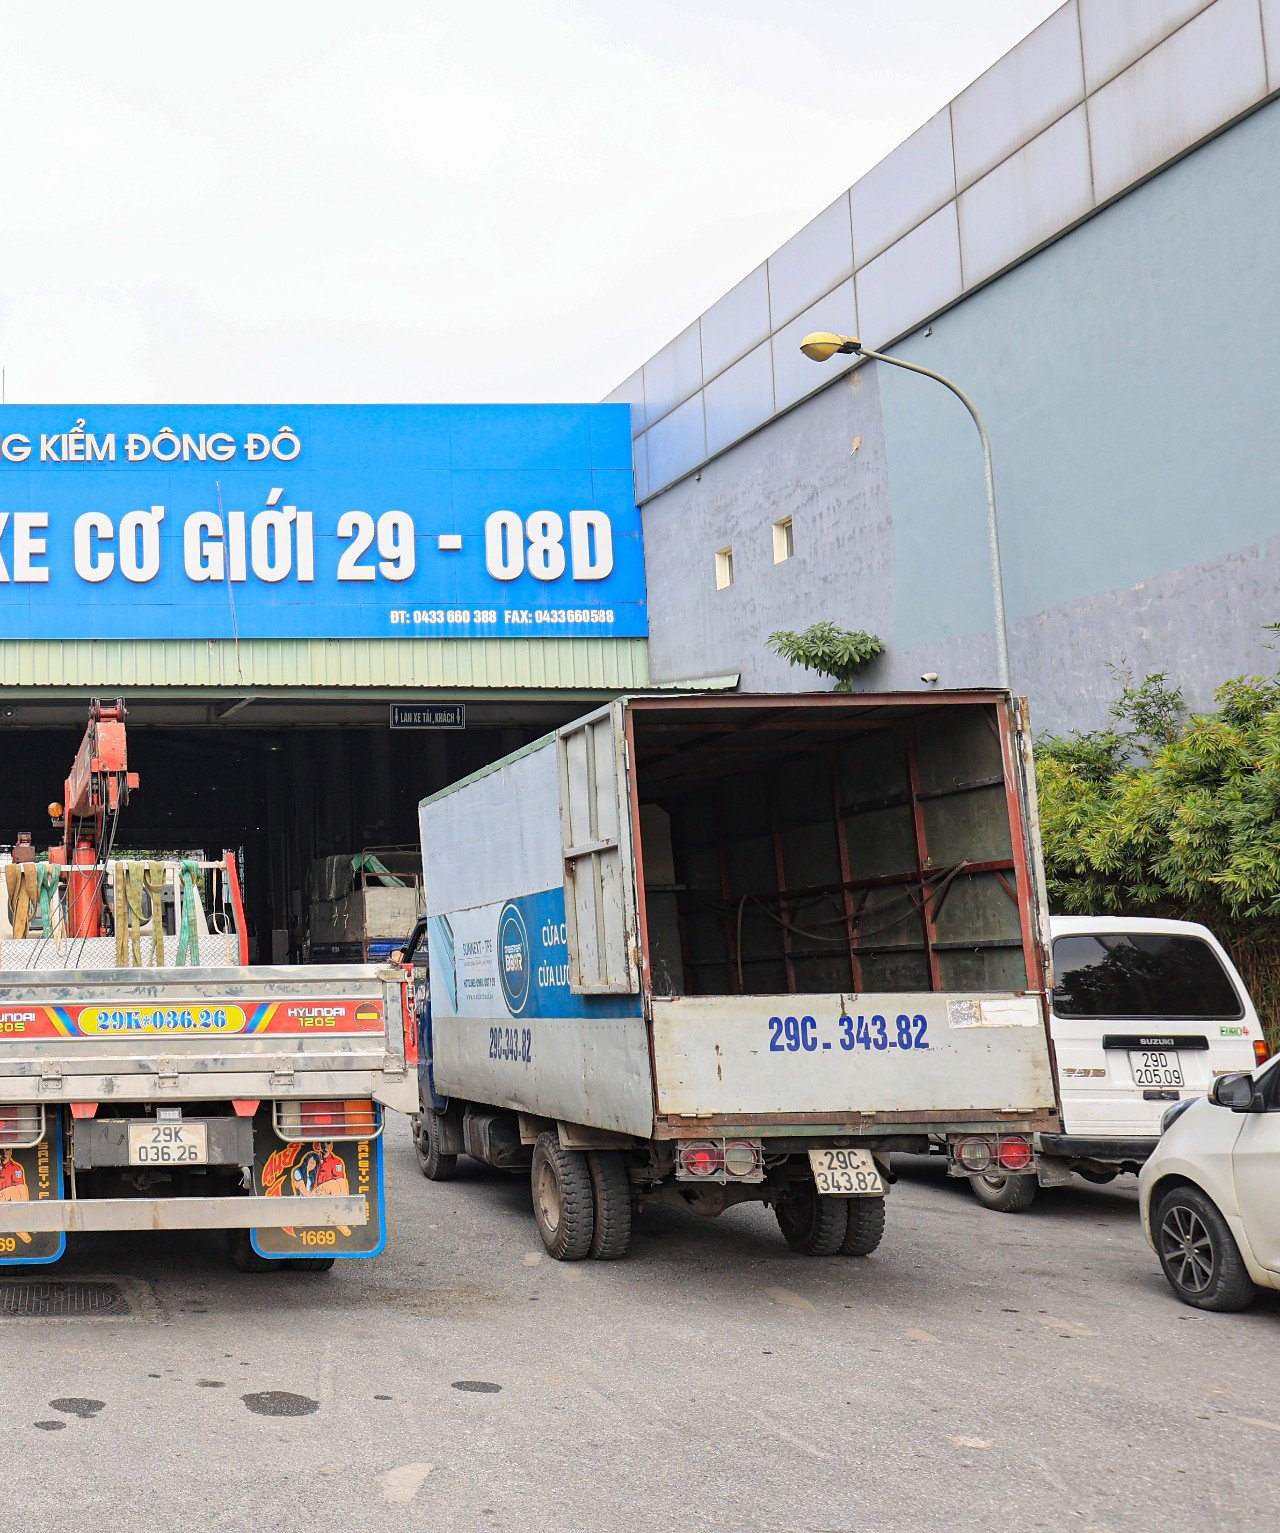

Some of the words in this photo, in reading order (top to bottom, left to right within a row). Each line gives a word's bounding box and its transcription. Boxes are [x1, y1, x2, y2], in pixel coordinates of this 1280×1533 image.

[40, 418, 116, 462] KIỂM
[125, 426, 236, 462] ĐÔNG
[244, 425, 302, 462] ĐÔ
[73, 505, 166, 583] CƠ
[183, 487, 314, 583] GIỚI
[336, 510, 416, 582] 29
[438, 534, 463, 550] -
[484, 509, 615, 582] 08D
[390, 610, 410, 624] ĐT:
[413, 609, 445, 624] 0433
[446, 609, 470, 624] 660
[473, 609, 497, 624] 388
[504, 610, 533, 624] FAX:
[413, 712, 421, 723] XE
[287, 1007, 346, 1018] HYUNDAI
[298, 1017, 336, 1028] 120S
[1140, 1038, 1175, 1046] SUZUKI
[1141, 1052, 1169, 1068] 29D
[1135, 1069, 1182, 1085] 205.09
[151, 1126, 184, 1143] 29K
[138, 1145, 199, 1162] 036.26
[824, 1150, 860, 1171] 29C
[817, 1171, 882, 1192] 343.82
[300, 1230, 336, 1245] 1669
